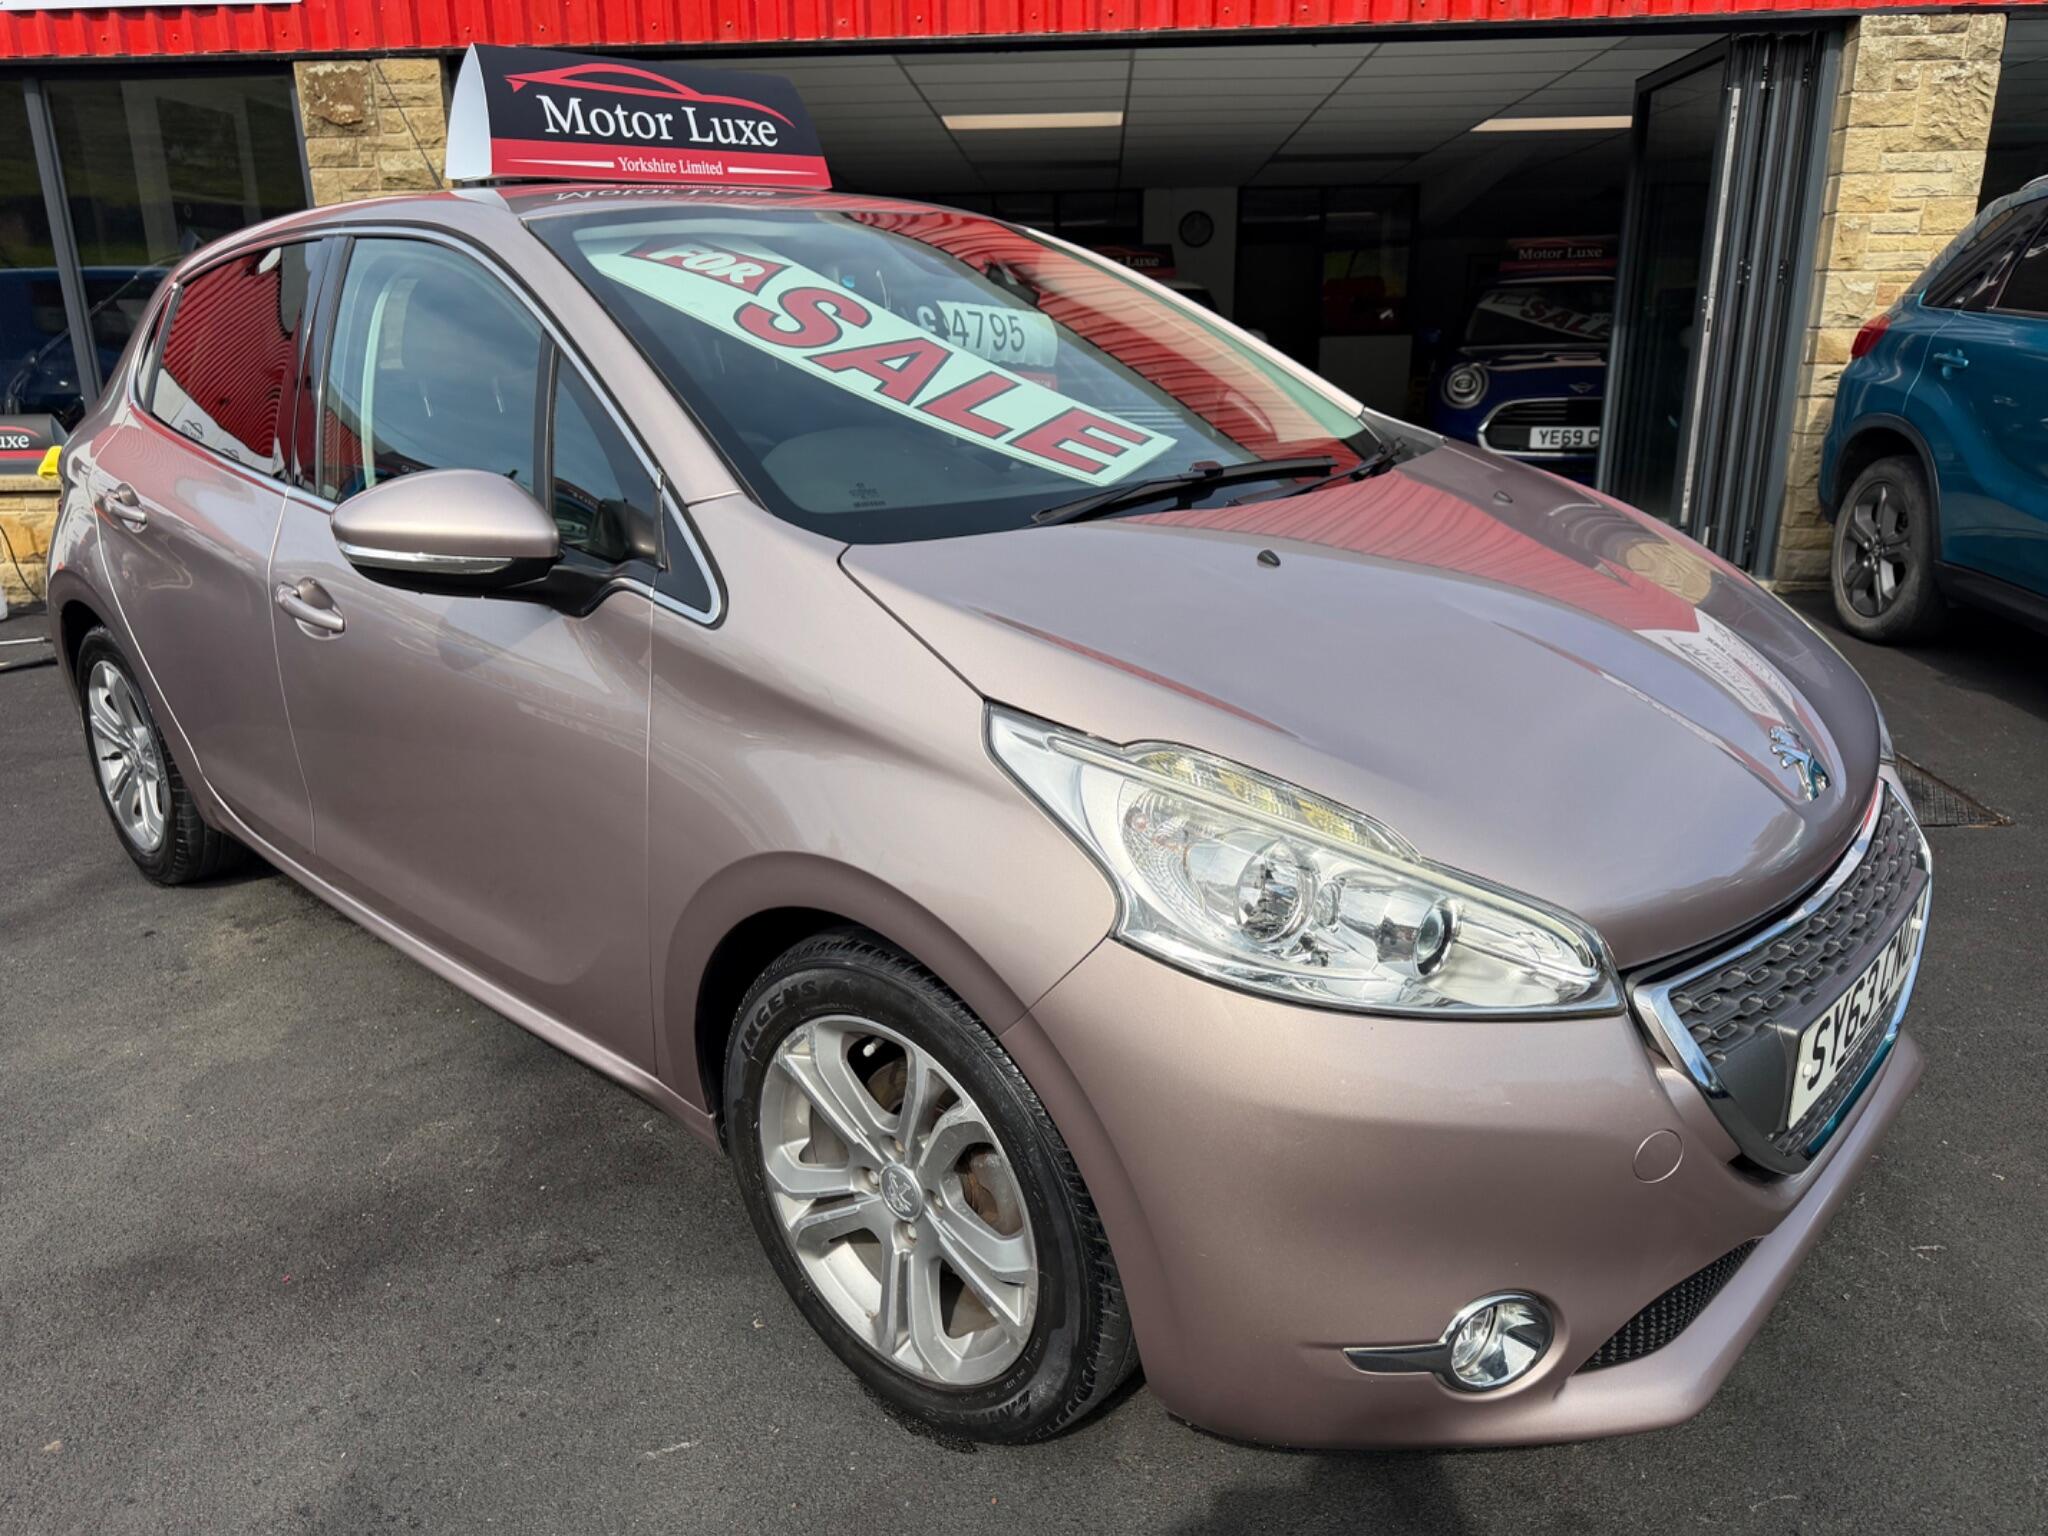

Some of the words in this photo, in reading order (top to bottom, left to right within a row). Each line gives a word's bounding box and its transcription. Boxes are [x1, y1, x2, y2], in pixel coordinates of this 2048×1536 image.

[536, 93, 674, 141] Motor
[681, 106, 778, 147] Luxe
[617, 156, 677, 175] Yorkshire
[679, 159, 723, 176] Limited
[646, 243, 766, 284] FOR
[1518, 248, 1563, 261] Motor
[1567, 247, 1604, 259] Luxe
[733, 286, 1154, 476] SALE
[1539, 429, 1584, 446] YE69
[1807, 958, 1881, 1091] SY63
